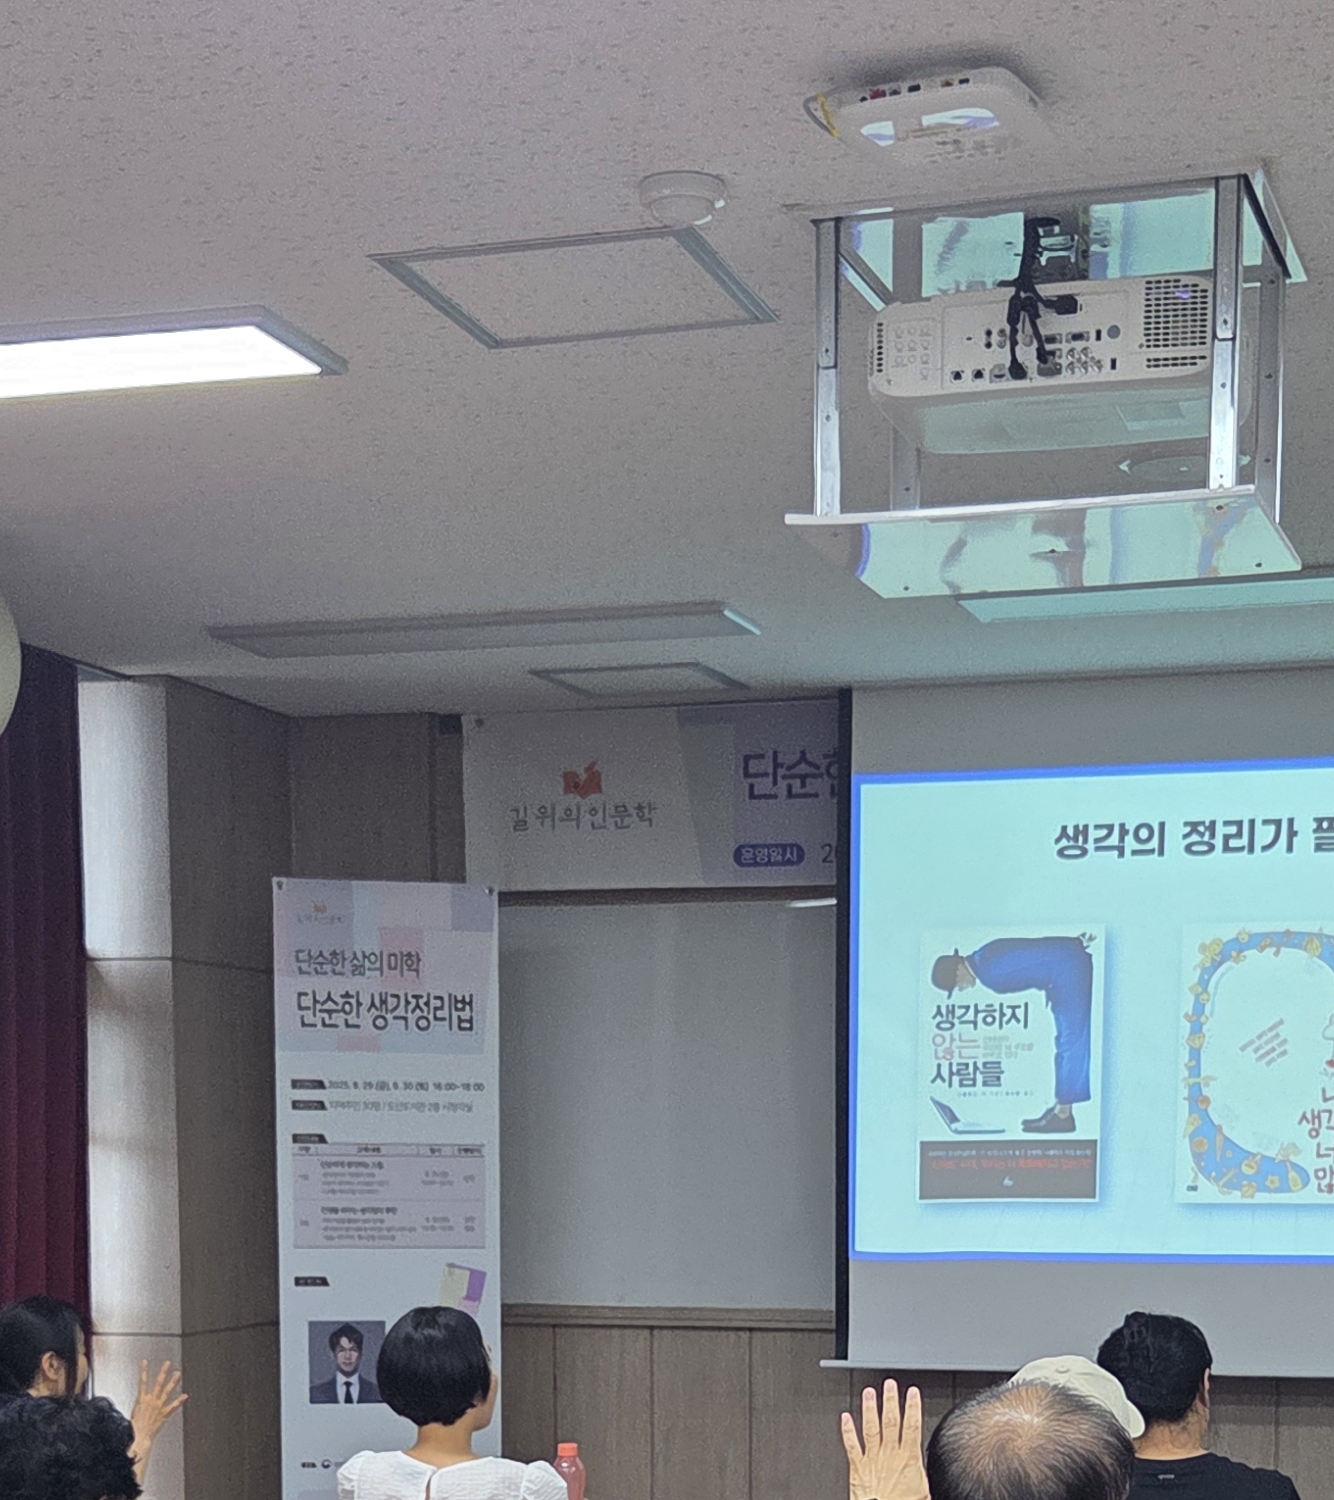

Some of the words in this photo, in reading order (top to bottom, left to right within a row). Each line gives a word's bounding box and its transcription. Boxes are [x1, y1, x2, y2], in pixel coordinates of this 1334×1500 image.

[1054, 820, 1166, 861] 생각의
[1181, 817, 1298, 857] 정리가
[294, 949, 347, 977] 단순한
[350, 949, 384, 978] 삶의
[387, 950, 422, 978] 미학
[296, 989, 363, 1030] 단순한
[367, 991, 475, 1032] 생각정리법
[931, 1001, 1029, 1032] 생각하지
[931, 1032, 981, 1061] 않는
[930, 1060, 1005, 1088] 사람들
